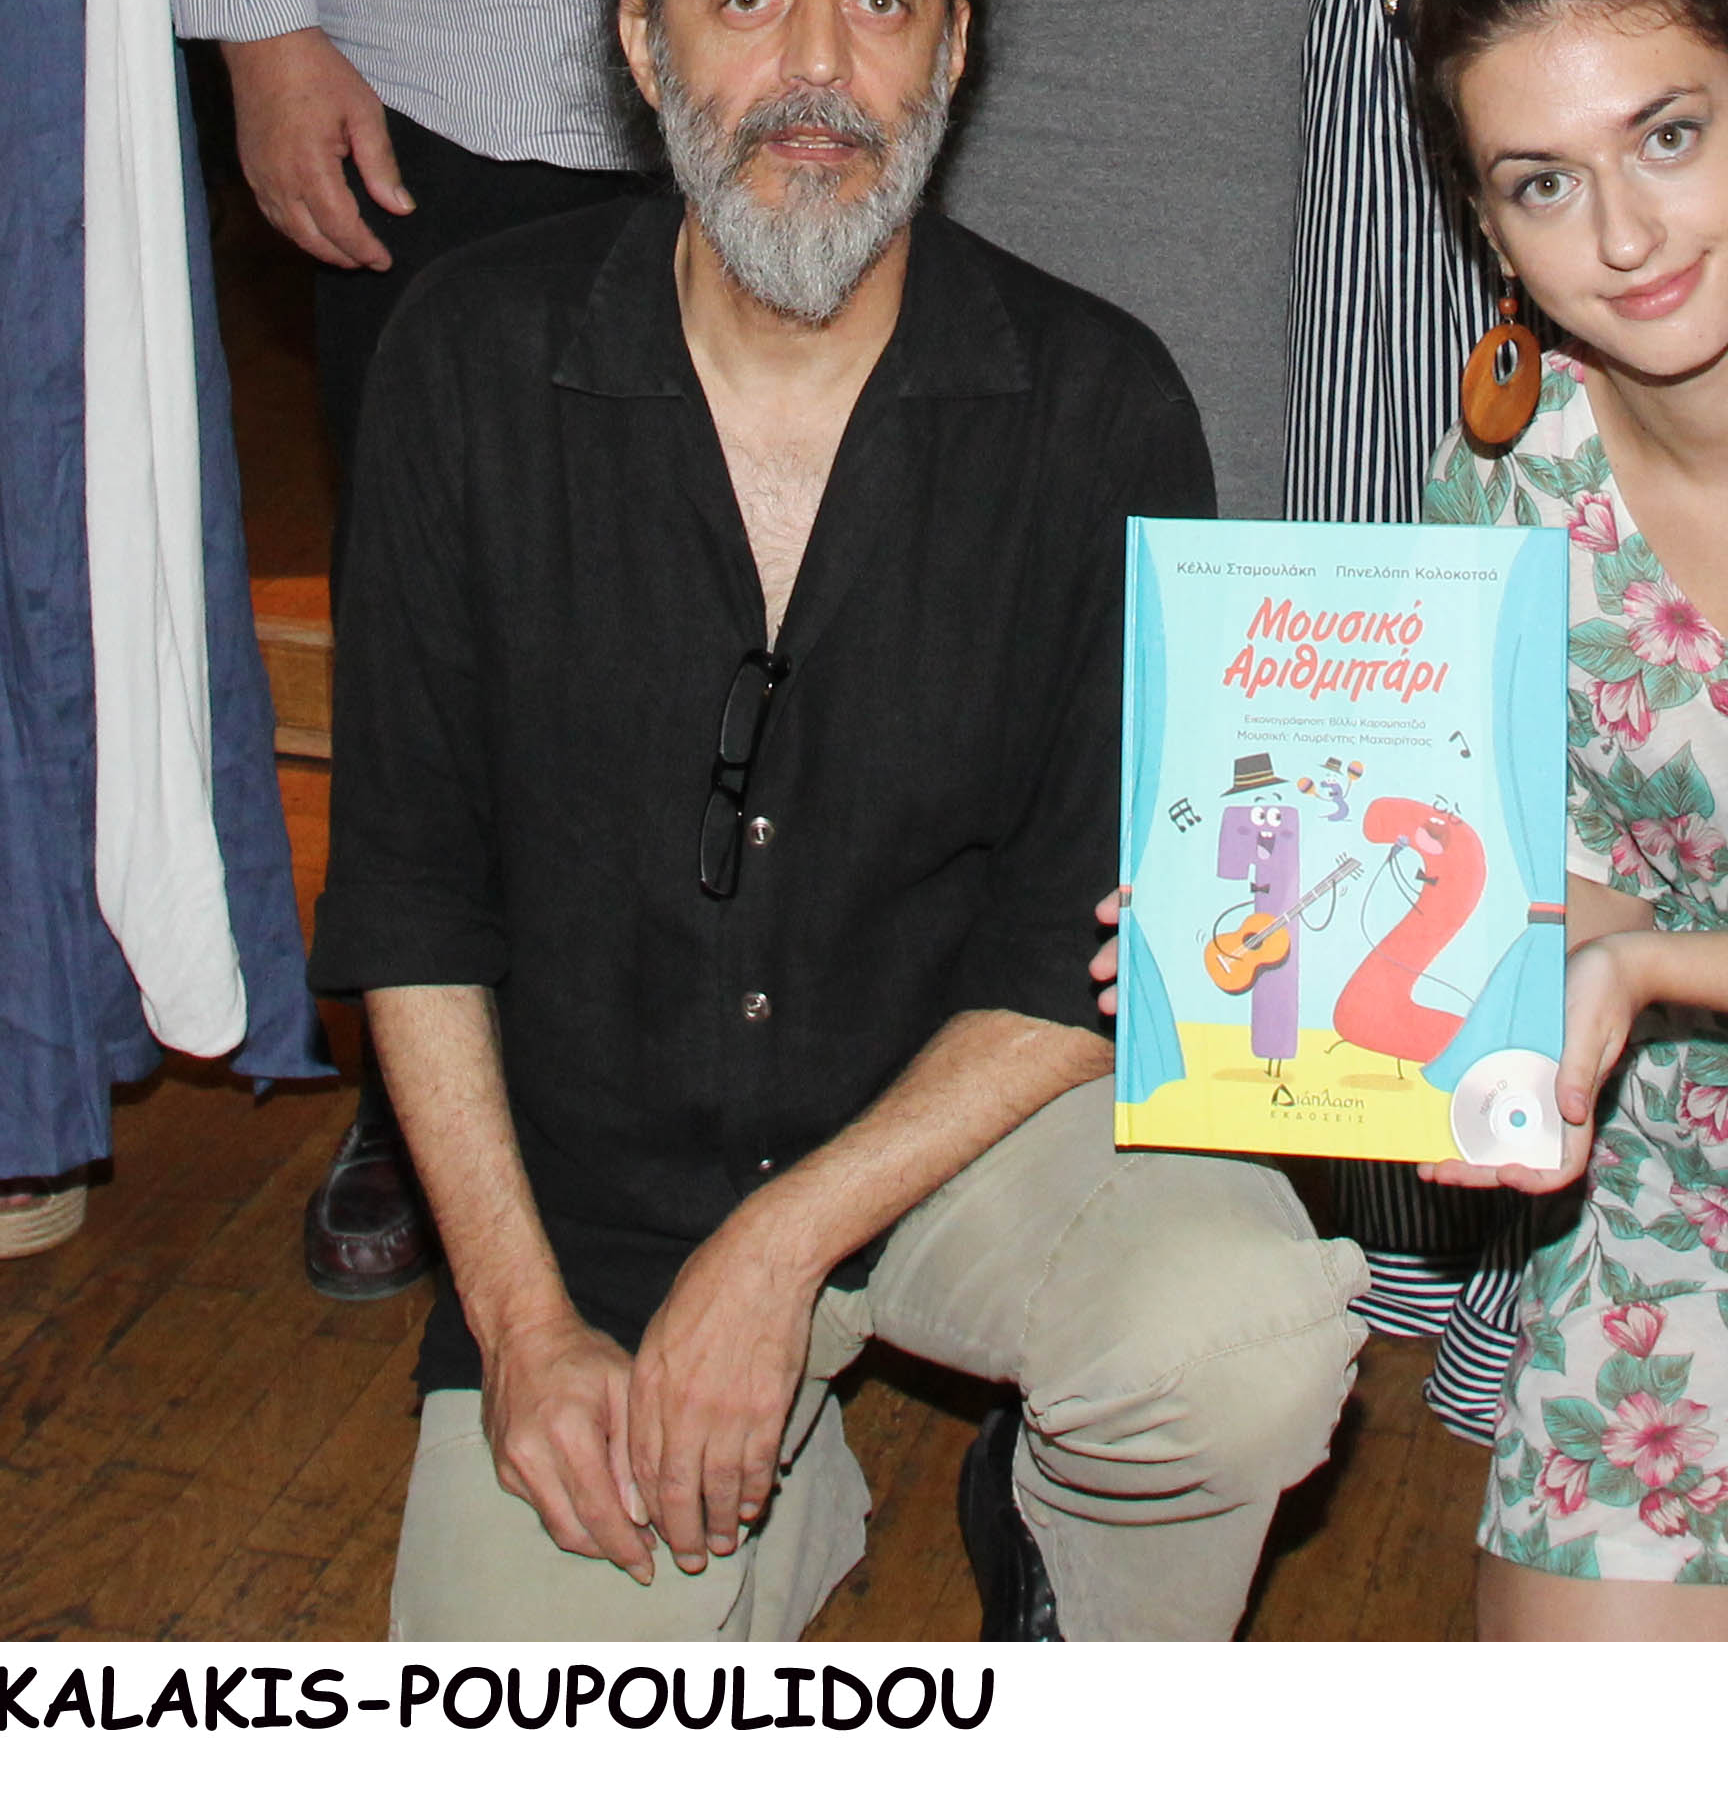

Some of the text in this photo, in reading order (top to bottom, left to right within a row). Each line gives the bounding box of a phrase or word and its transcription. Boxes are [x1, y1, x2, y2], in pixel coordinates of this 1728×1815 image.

[1176, 560, 1498, 582] Κέλλυ Σταμουλάκη Πηνελόπη Κολοκοτσά
[1246, 596, 1425, 645] Μουσικό
[1222, 643, 1450, 704] Αριθμητάρι
